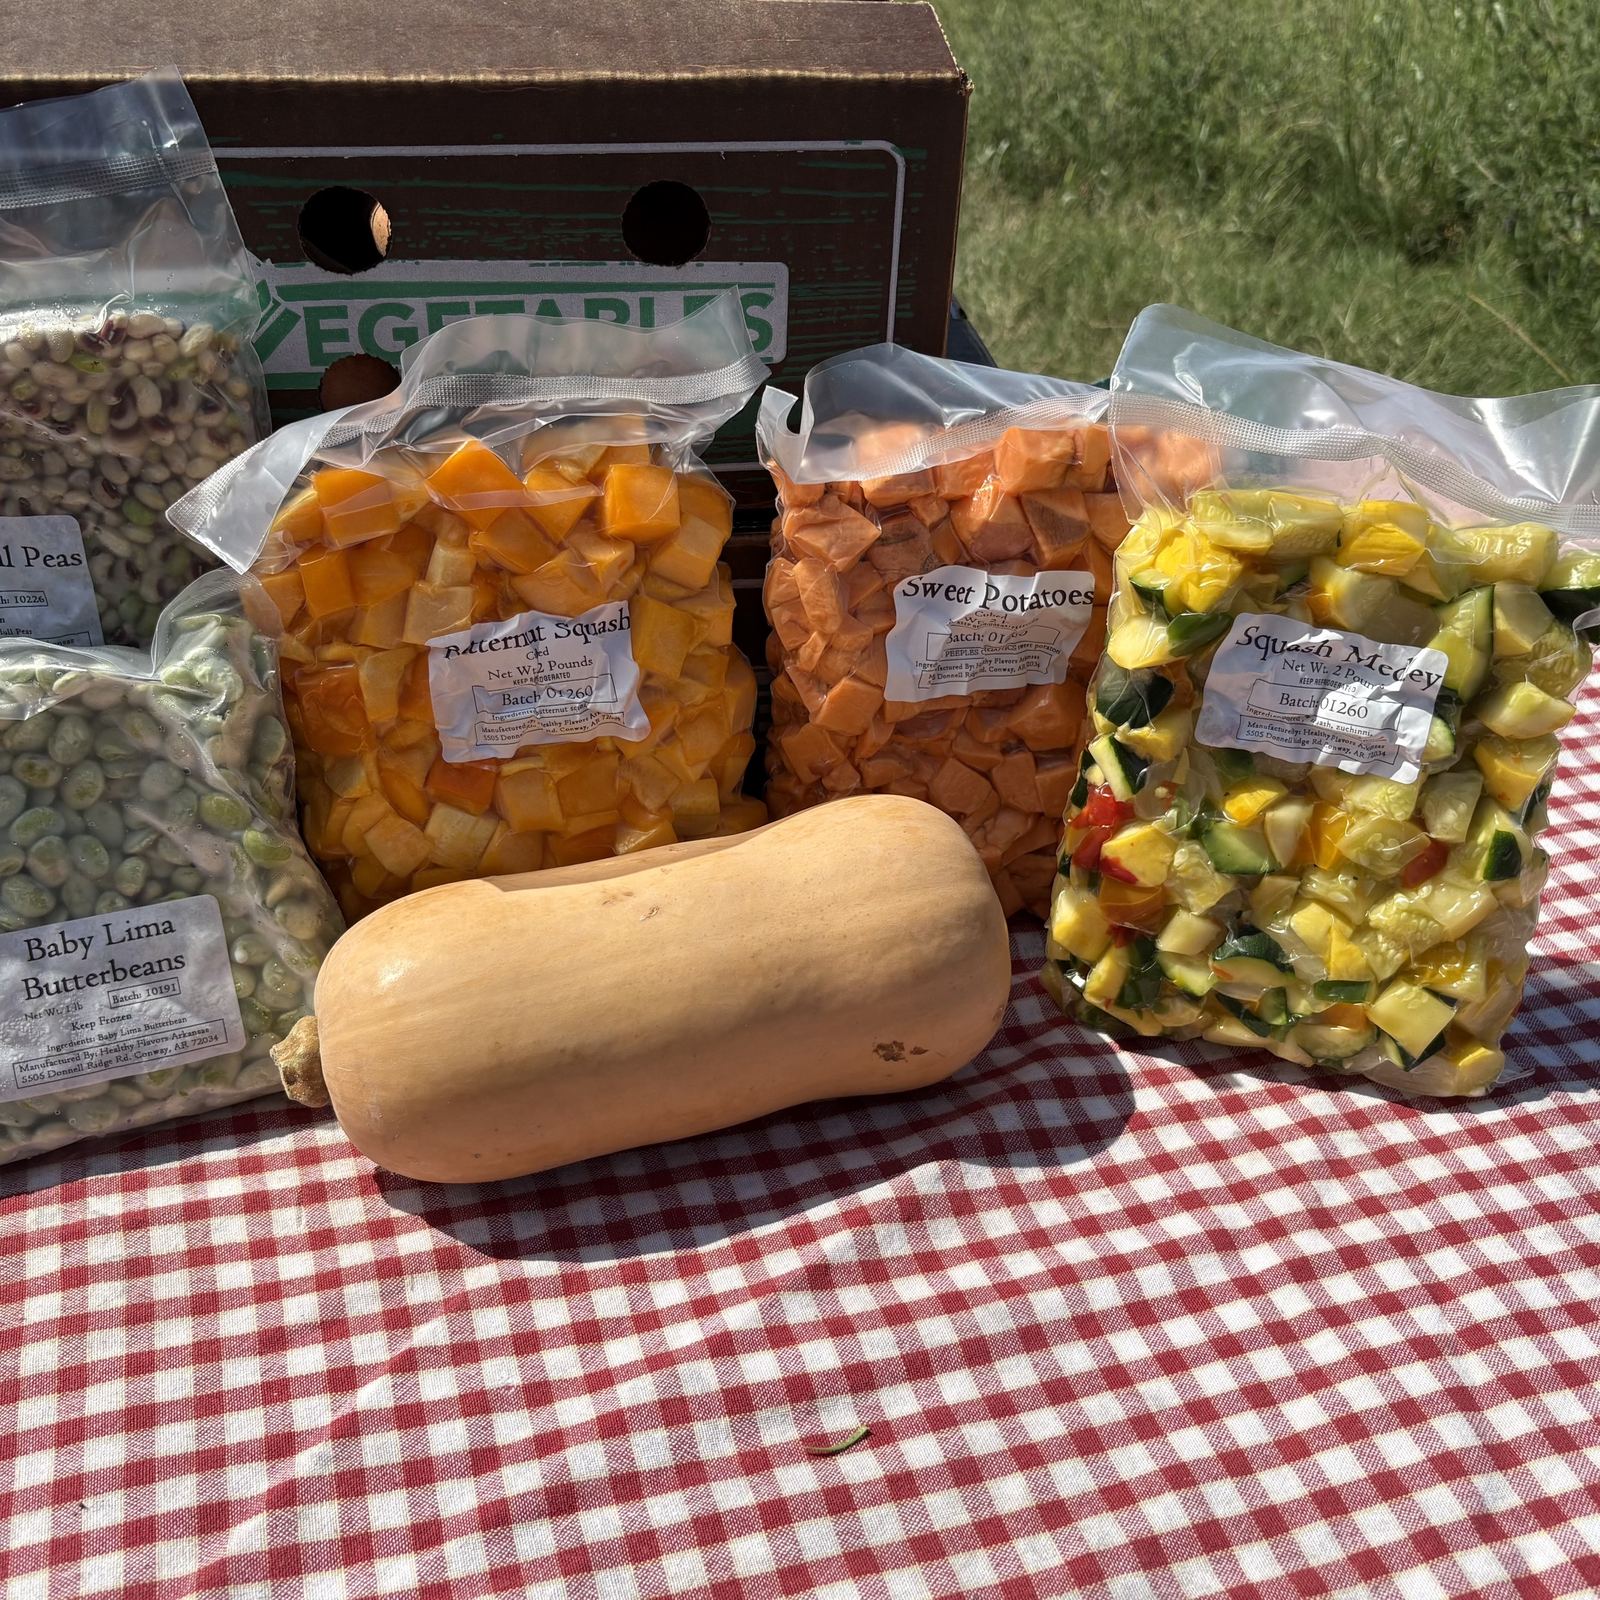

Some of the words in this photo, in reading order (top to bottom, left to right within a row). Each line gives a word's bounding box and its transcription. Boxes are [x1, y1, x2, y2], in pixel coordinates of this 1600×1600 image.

[21, 545, 83, 568] Peas
[14, 594, 45, 604] 10226
[902, 576, 976, 605] Sweet
[978, 582, 1096, 616] Potatoes
[444, 625, 547, 659] Btternut
[554, 608, 632, 645] Squash
[487, 669, 513, 681] Net
[549, 657, 594, 671] Pounds
[1236, 625, 1333, 661] Squash
[1342, 645, 1443, 692] Medey
[1282, 658, 1306, 673] Net
[1332, 665, 1342, 677] 2
[1299, 677, 1313, 686] KEEP
[1280, 692, 1319, 710] Batch:
[1319, 697, 1369, 720] 01260
[1303, 728, 1331, 742] Healthy
[24, 930, 95, 962] Baby
[103, 919, 176, 946] Lima
[21, 953, 187, 1001] Butterbeans
[111, 991, 142, 1005] Batch:
[145, 983, 178, 997] 10191
[47, 1035, 96, 1053] Ingredients:
[97, 1030, 119, 1043] Baby
[120, 1025, 143, 1037] Lima
[143, 1016, 188, 1033] Butterbean
[71, 1019, 97, 1033] Keep
[98, 1012, 133, 1026] Frozen
[19, 1053, 82, 1074] Manufactured
[83, 1049, 98, 1063] By:
[100, 1042, 135, 1058] Healthy
[47, 1063, 84, 1079] Donnell
[86, 1057, 114, 1072] Ridge
[115, 1052, 132, 1065] Rd.
[134, 1045, 173, 1060] Conway,
[174, 1039, 190, 1051] AR
[190, 1033, 219, 1047] 72034
